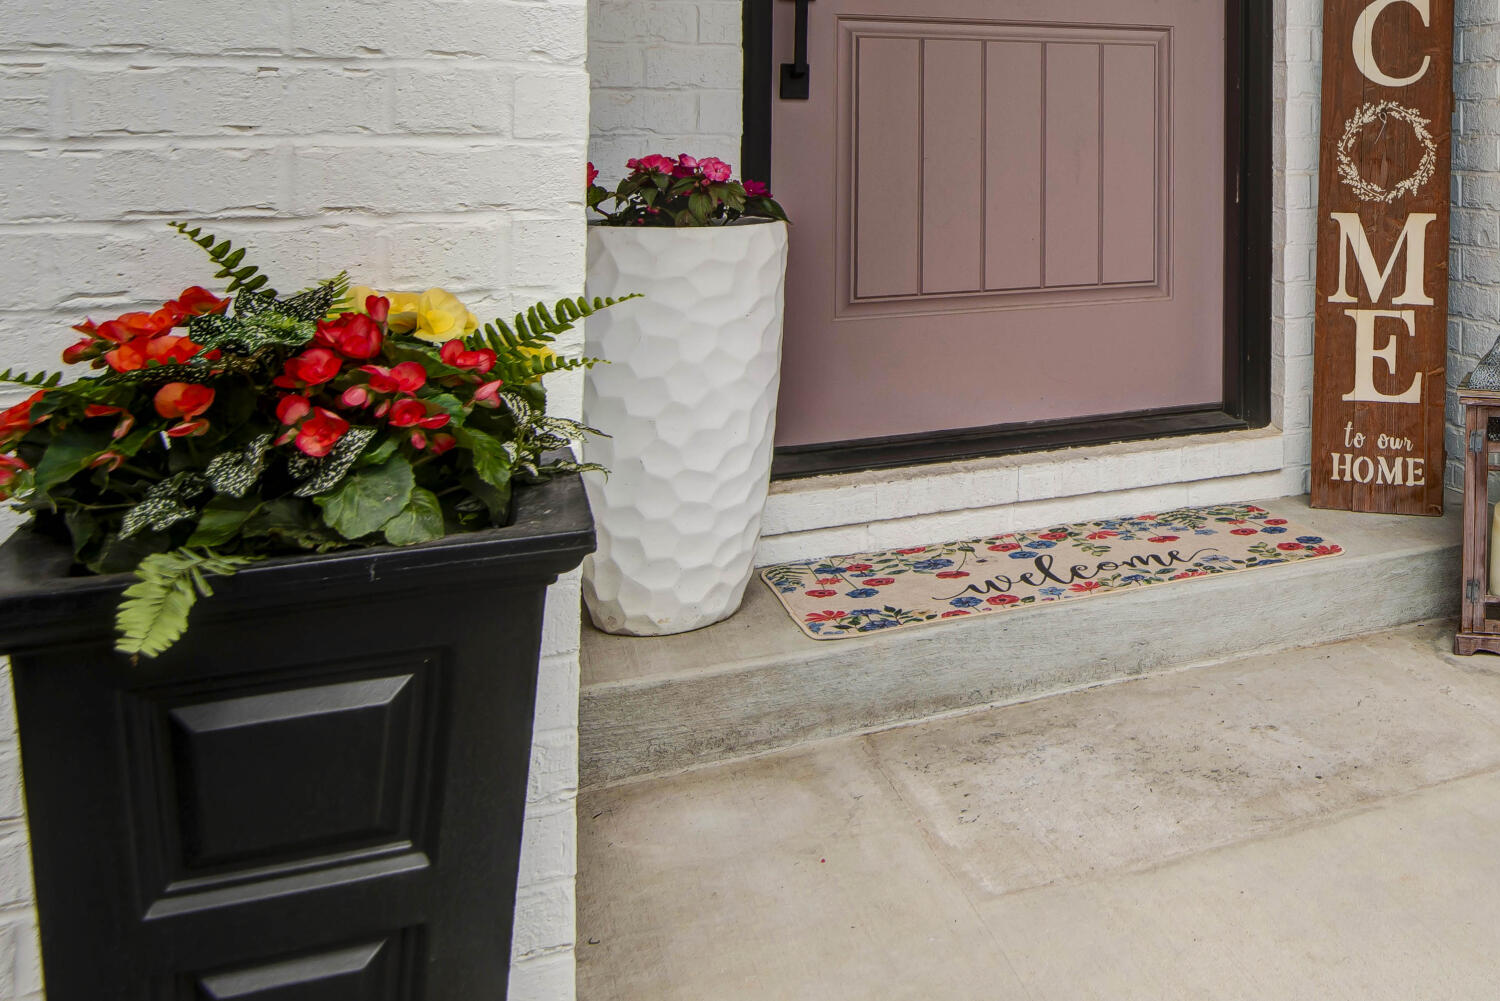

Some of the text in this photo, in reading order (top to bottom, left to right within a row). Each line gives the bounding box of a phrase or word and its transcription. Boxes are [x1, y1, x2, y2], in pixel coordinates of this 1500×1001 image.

[1343, 421, 1414, 452] to our
[1330, 452, 1425, 487] HOME
[932, 546, 1219, 601] welcome
